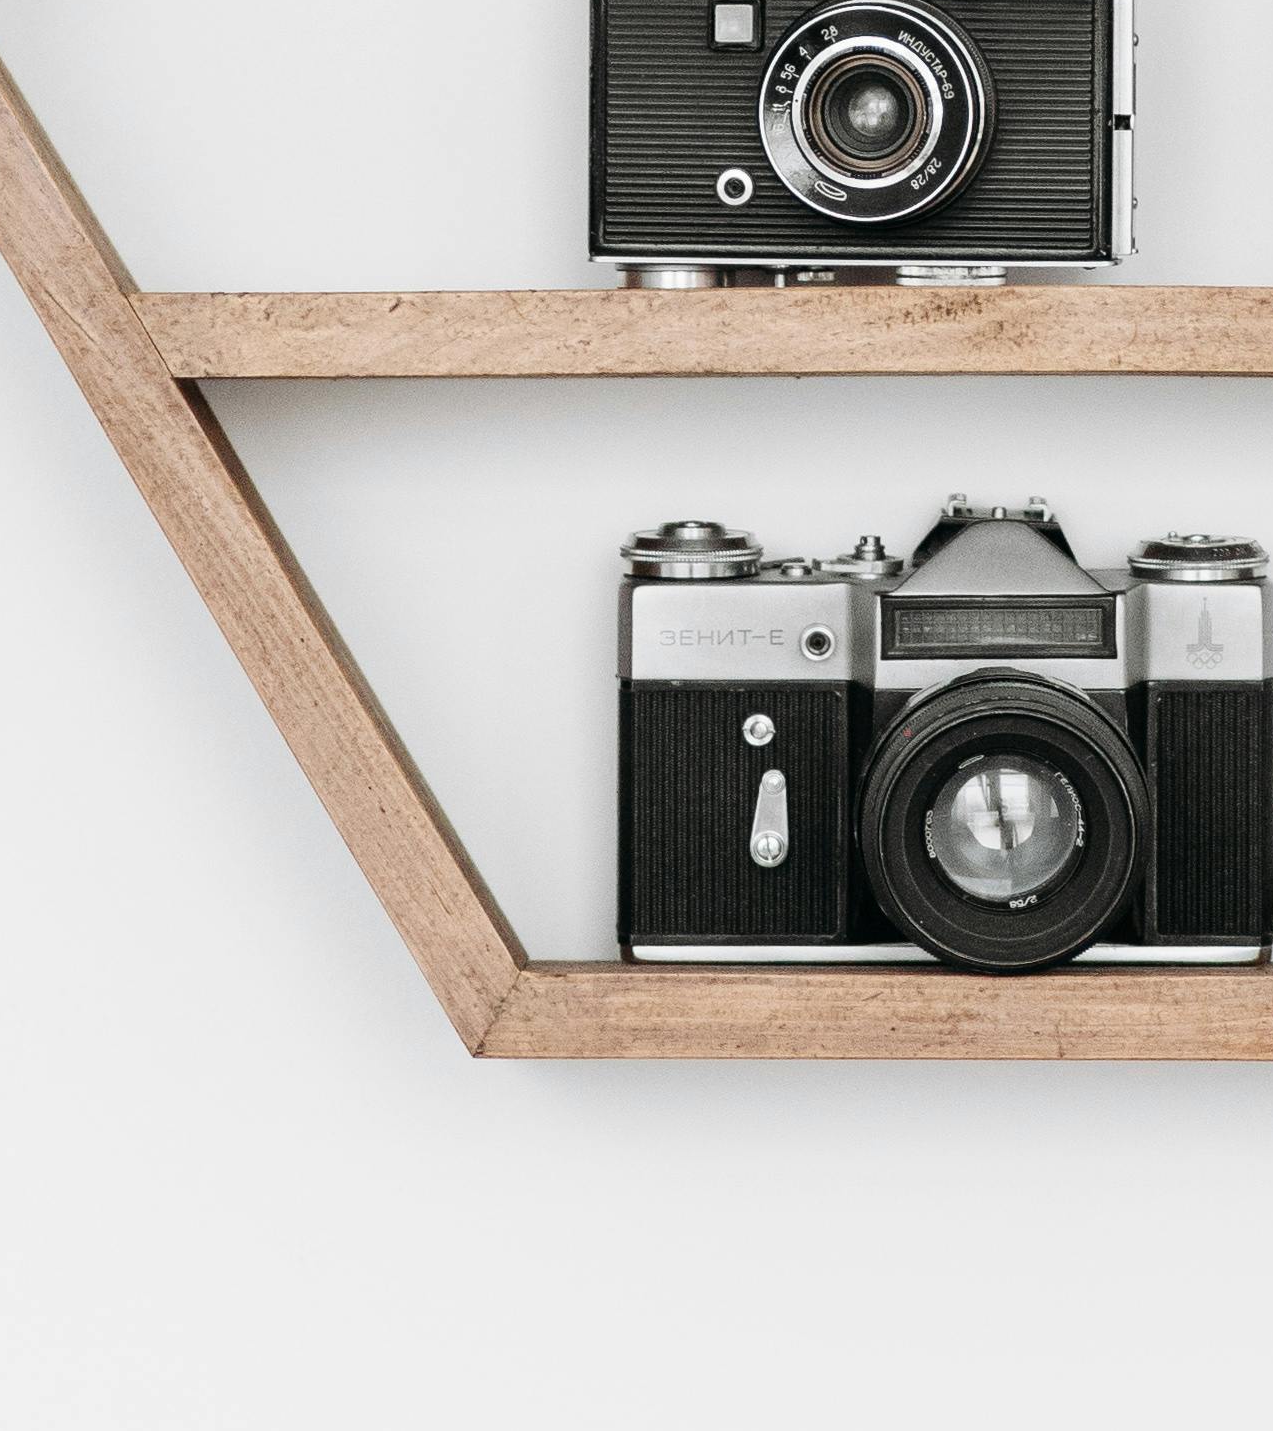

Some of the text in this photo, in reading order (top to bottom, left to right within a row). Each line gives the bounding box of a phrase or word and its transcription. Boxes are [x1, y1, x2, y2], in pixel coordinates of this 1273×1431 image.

[898, 30, 955, 100] ИНДУСТАР-69
[775, 85, 787, 94] 8
[659, 629, 785, 646] ЗЕНИТ-Е
